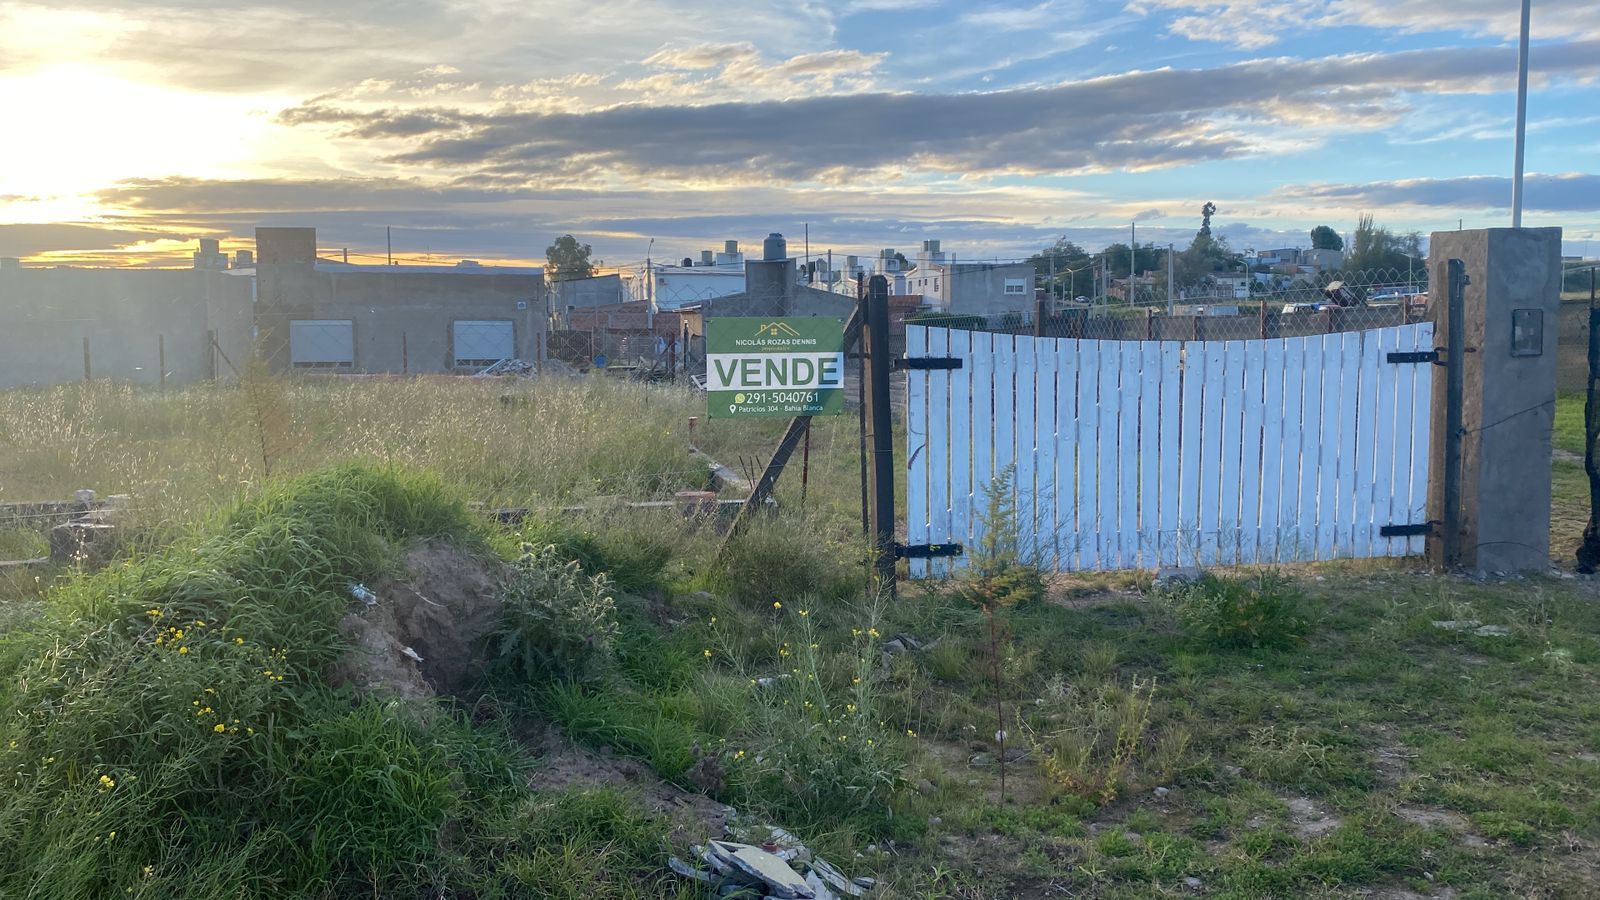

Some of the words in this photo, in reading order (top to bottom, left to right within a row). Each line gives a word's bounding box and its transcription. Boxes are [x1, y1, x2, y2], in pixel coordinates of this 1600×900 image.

[768, 338, 790, 346] ROZAS
[713, 358, 838, 387] VENDE
[746, 391, 818, 404] 291-5040761
